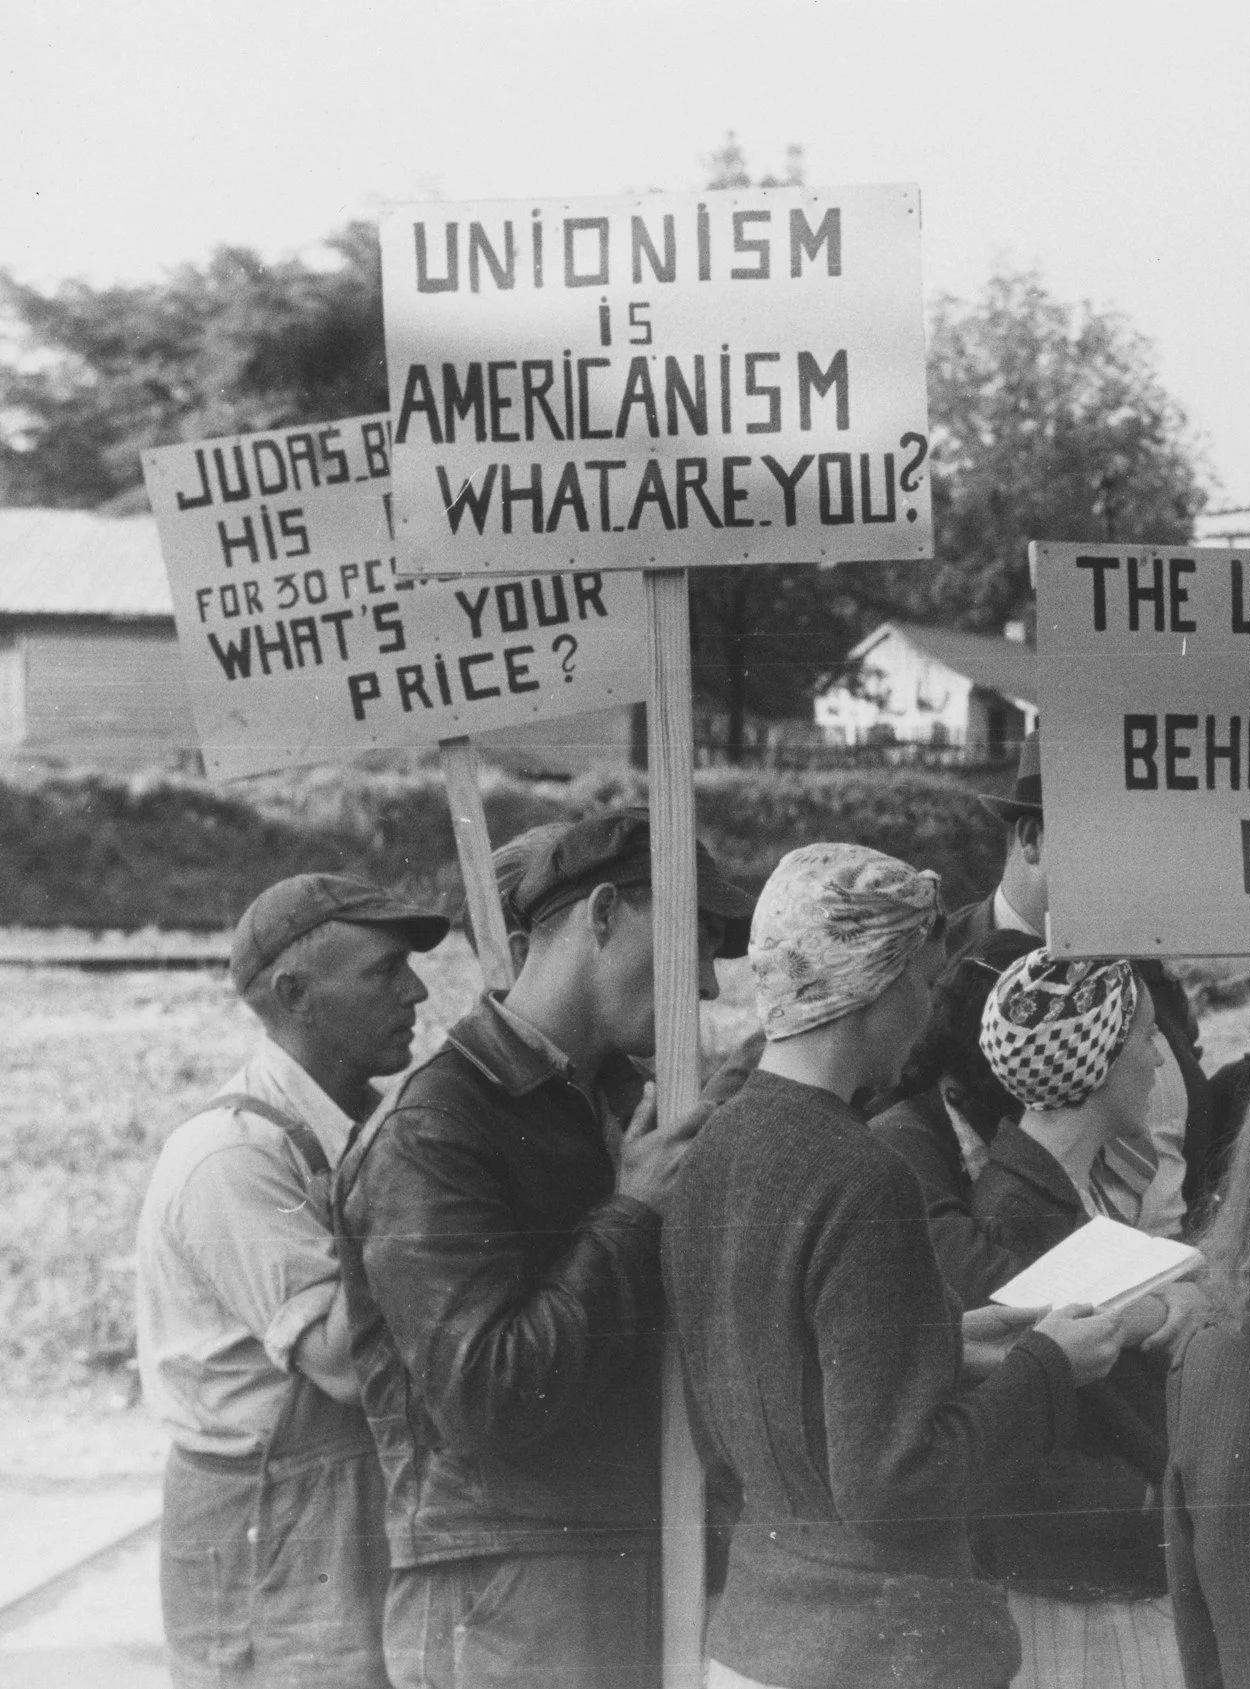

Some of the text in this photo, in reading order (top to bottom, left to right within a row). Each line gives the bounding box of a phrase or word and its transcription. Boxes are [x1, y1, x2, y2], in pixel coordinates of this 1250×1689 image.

[195, 579, 265, 624] FOR
[273, 567, 329, 610] 30
[207, 570, 610, 682] WHAT'S YOUR
[1075, 555, 1198, 634] THE
